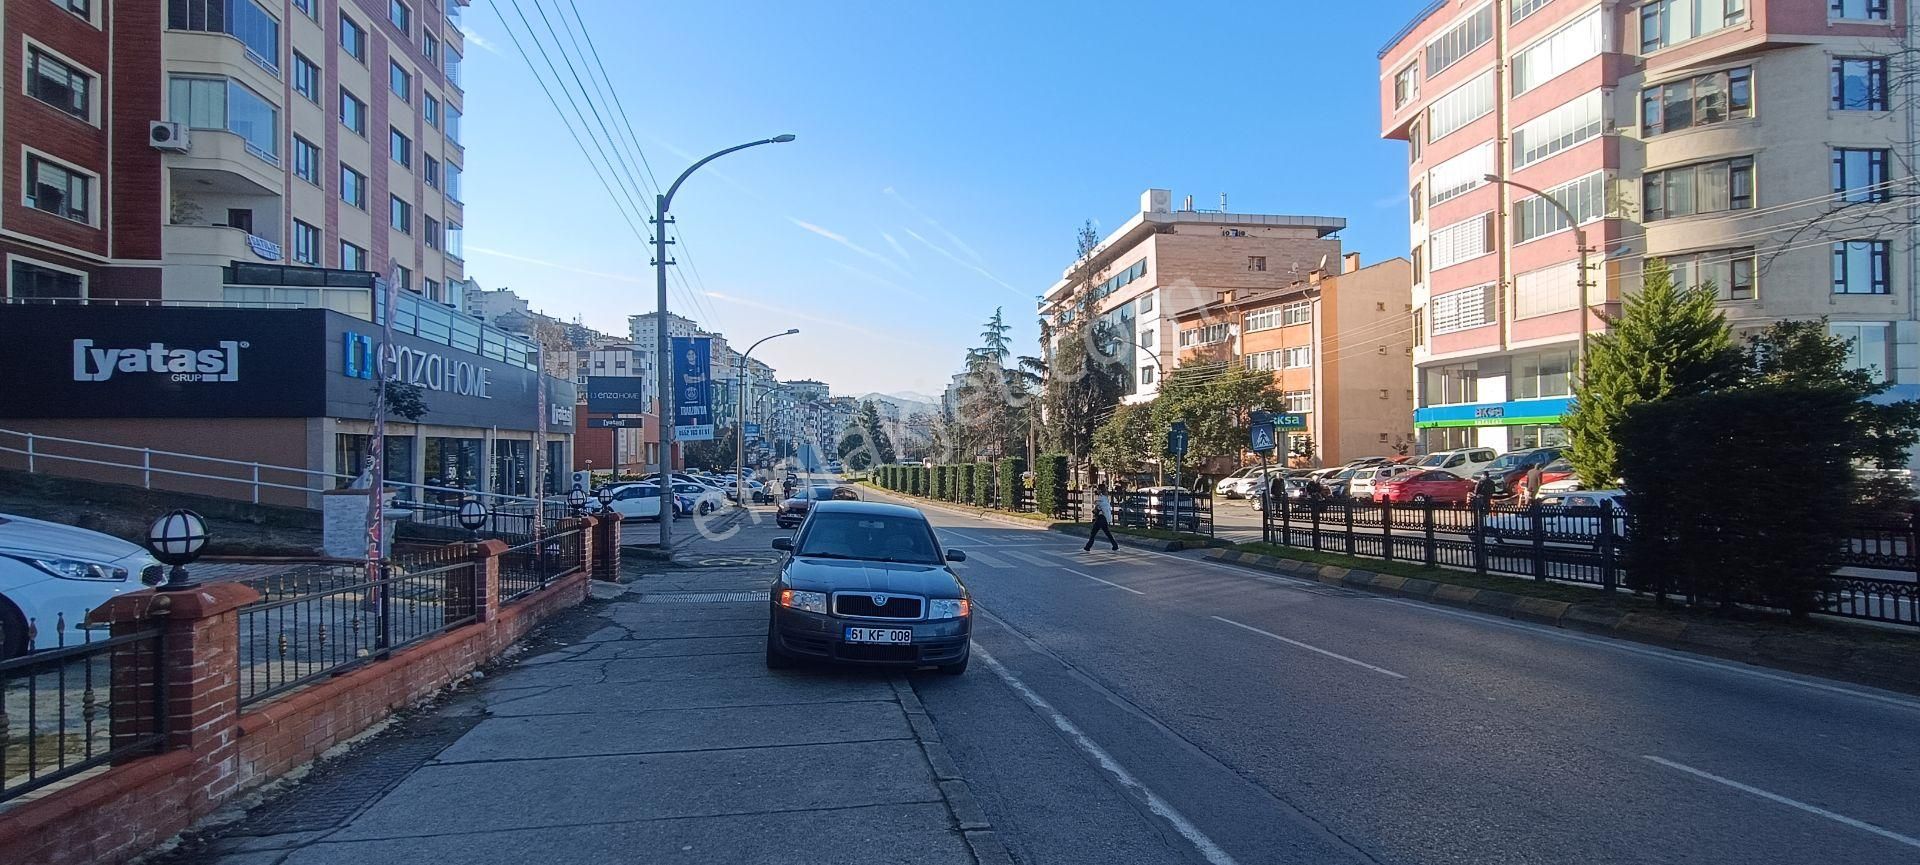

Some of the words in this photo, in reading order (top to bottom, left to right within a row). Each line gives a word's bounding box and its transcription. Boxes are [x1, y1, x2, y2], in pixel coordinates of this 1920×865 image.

[171, 374, 202, 382] GRUP
[851, 628, 863, 640] 61
[868, 629, 886, 641] KF
[891, 630, 910, 642] 008
